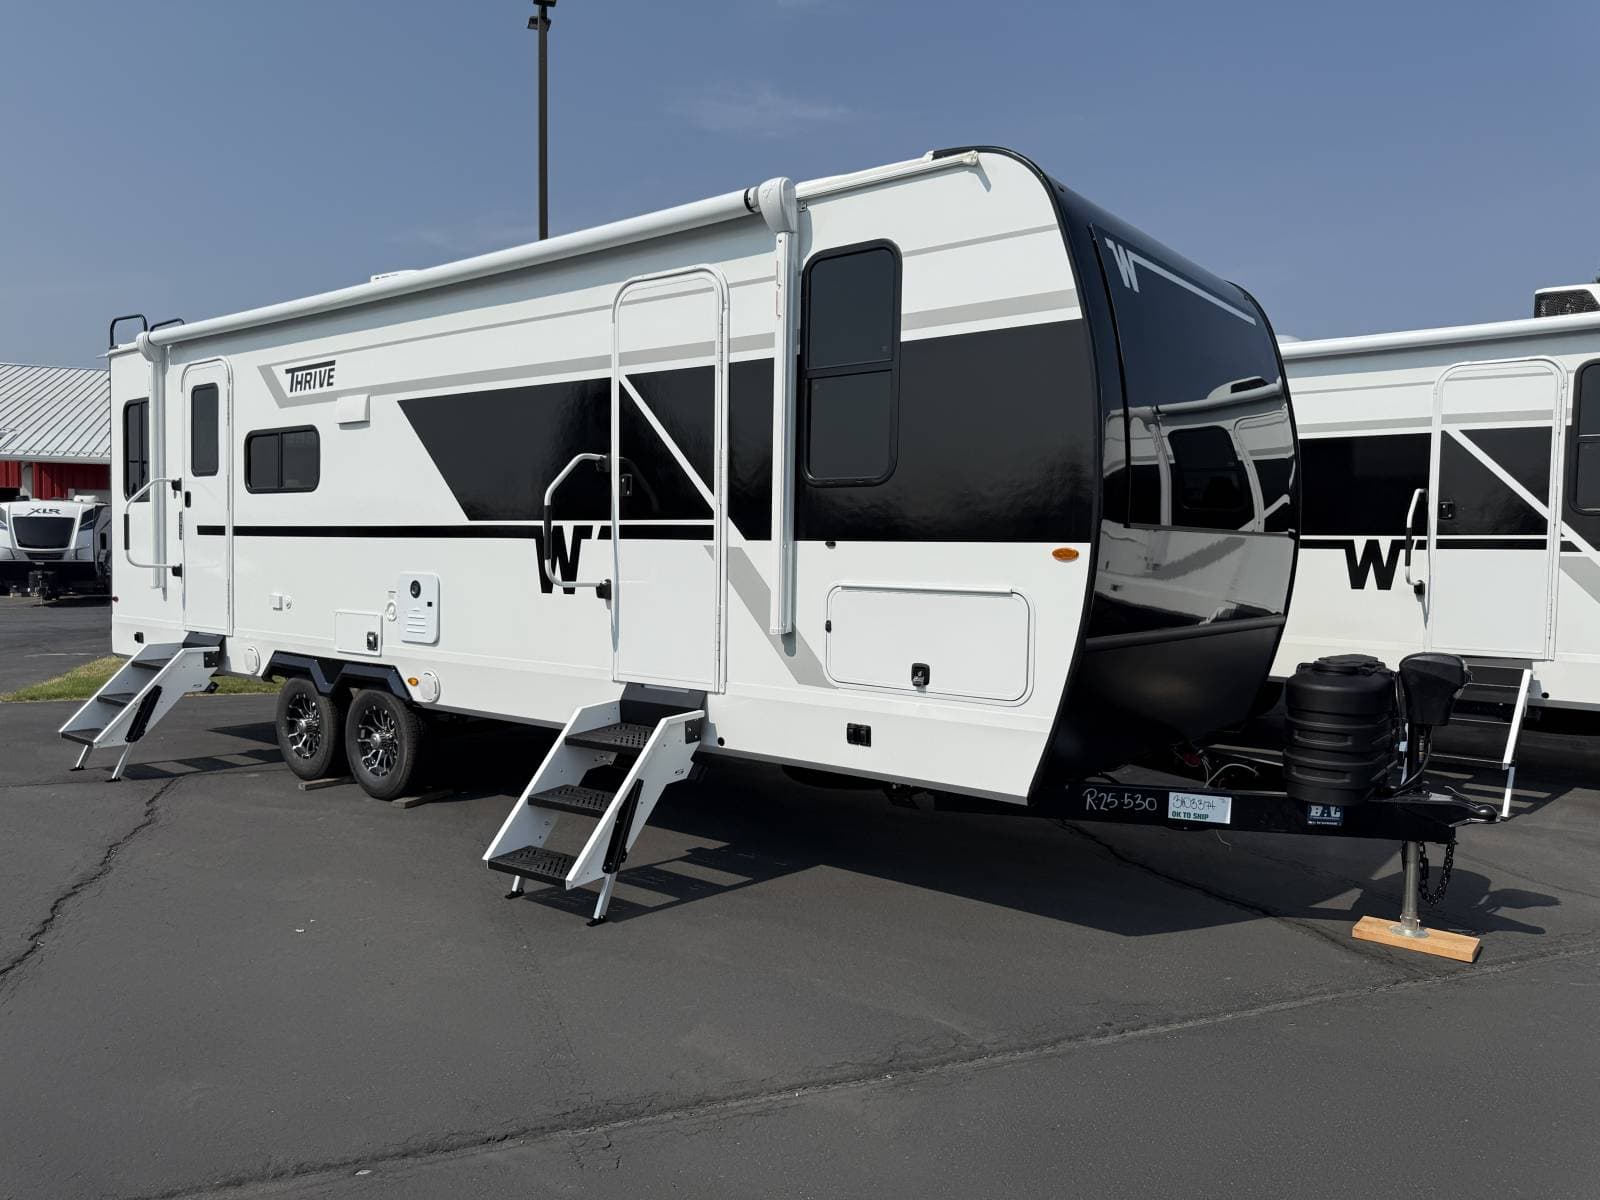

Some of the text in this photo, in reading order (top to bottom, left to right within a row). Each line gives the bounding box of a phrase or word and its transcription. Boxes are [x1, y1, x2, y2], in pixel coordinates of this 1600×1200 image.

[285, 359, 336, 393] THRIVE
[1171, 810, 1182, 818] OK
[1183, 811, 1192, 819] TO
